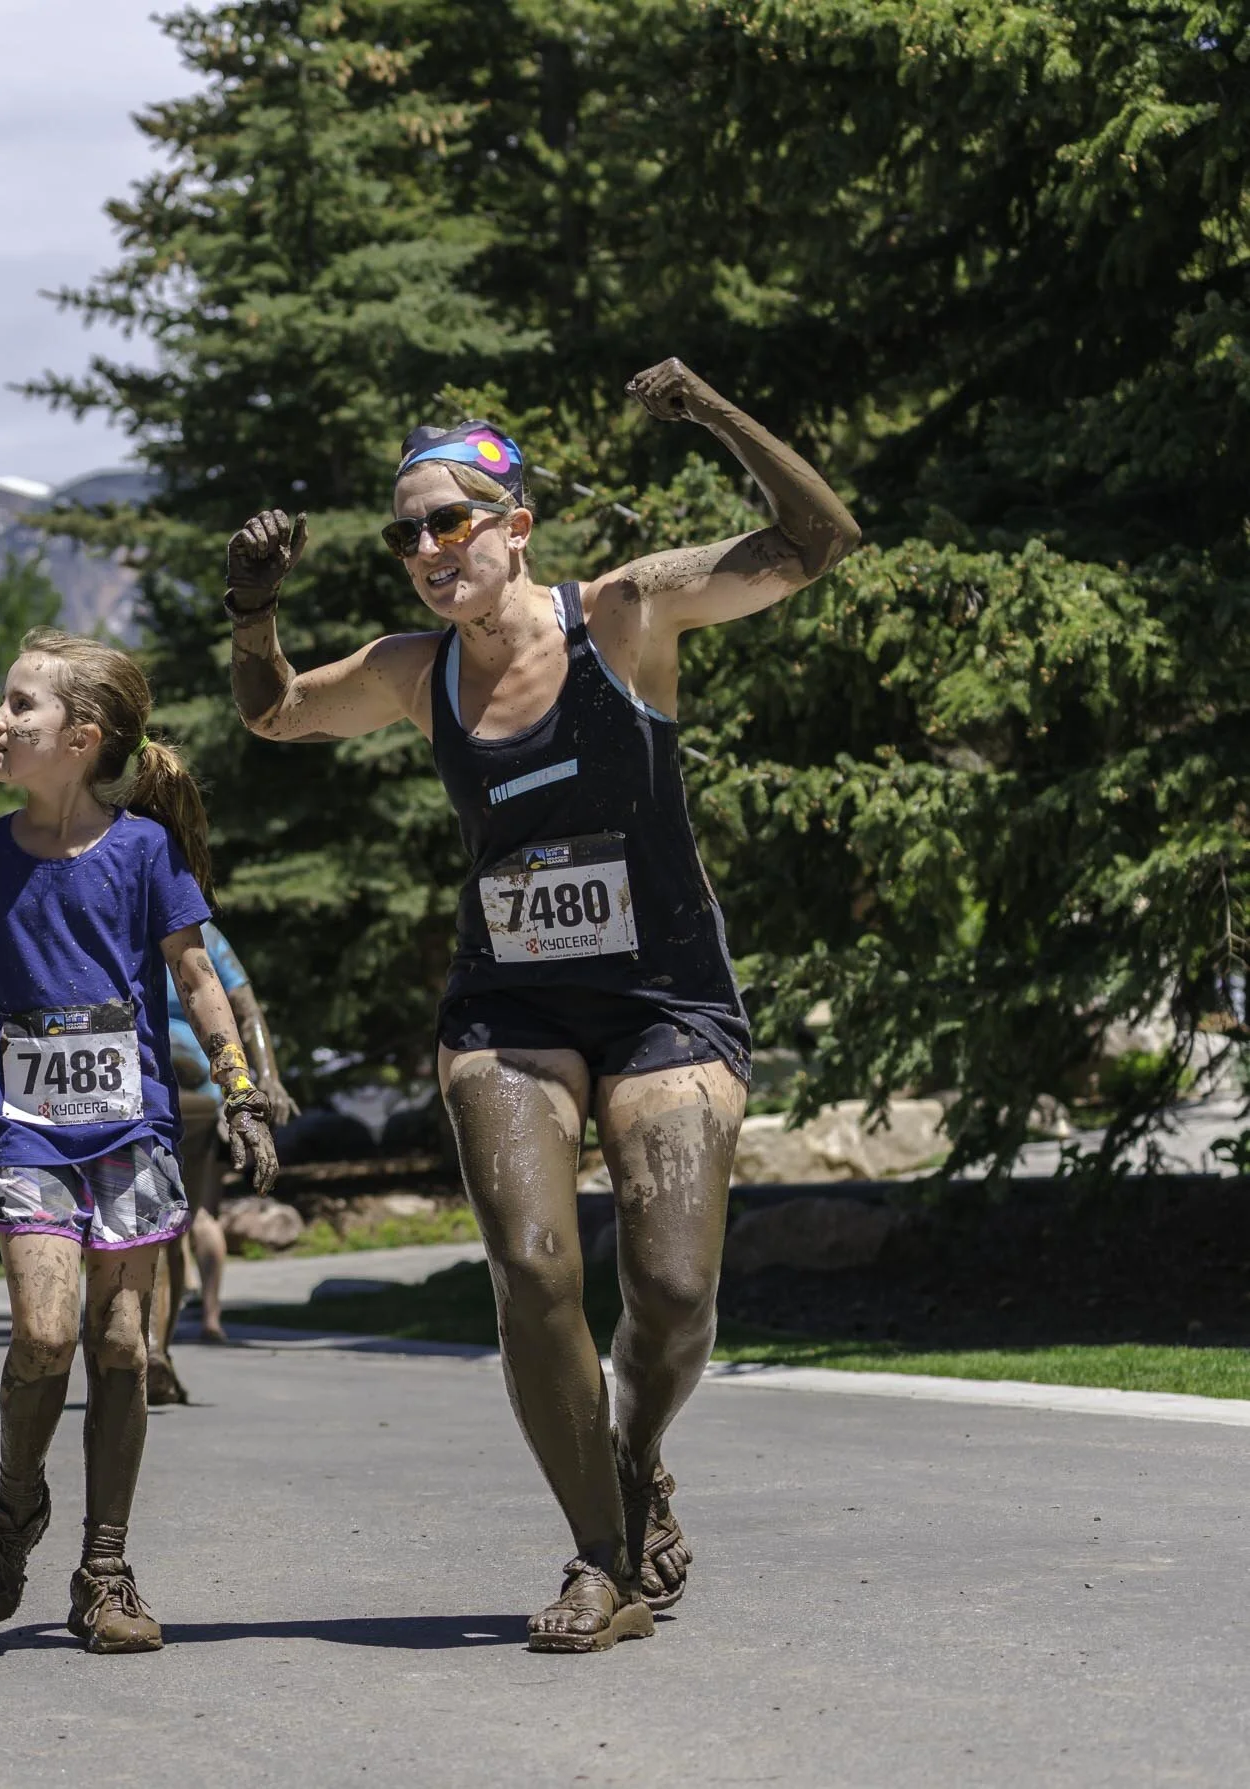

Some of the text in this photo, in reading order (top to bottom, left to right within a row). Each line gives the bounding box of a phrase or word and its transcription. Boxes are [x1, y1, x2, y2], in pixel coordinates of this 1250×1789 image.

[498, 879, 611, 932] 7480
[540, 934, 597, 951] KYOCERA
[17, 1047, 123, 1095] 7483
[51, 1101, 109, 1116] KYOCERA
